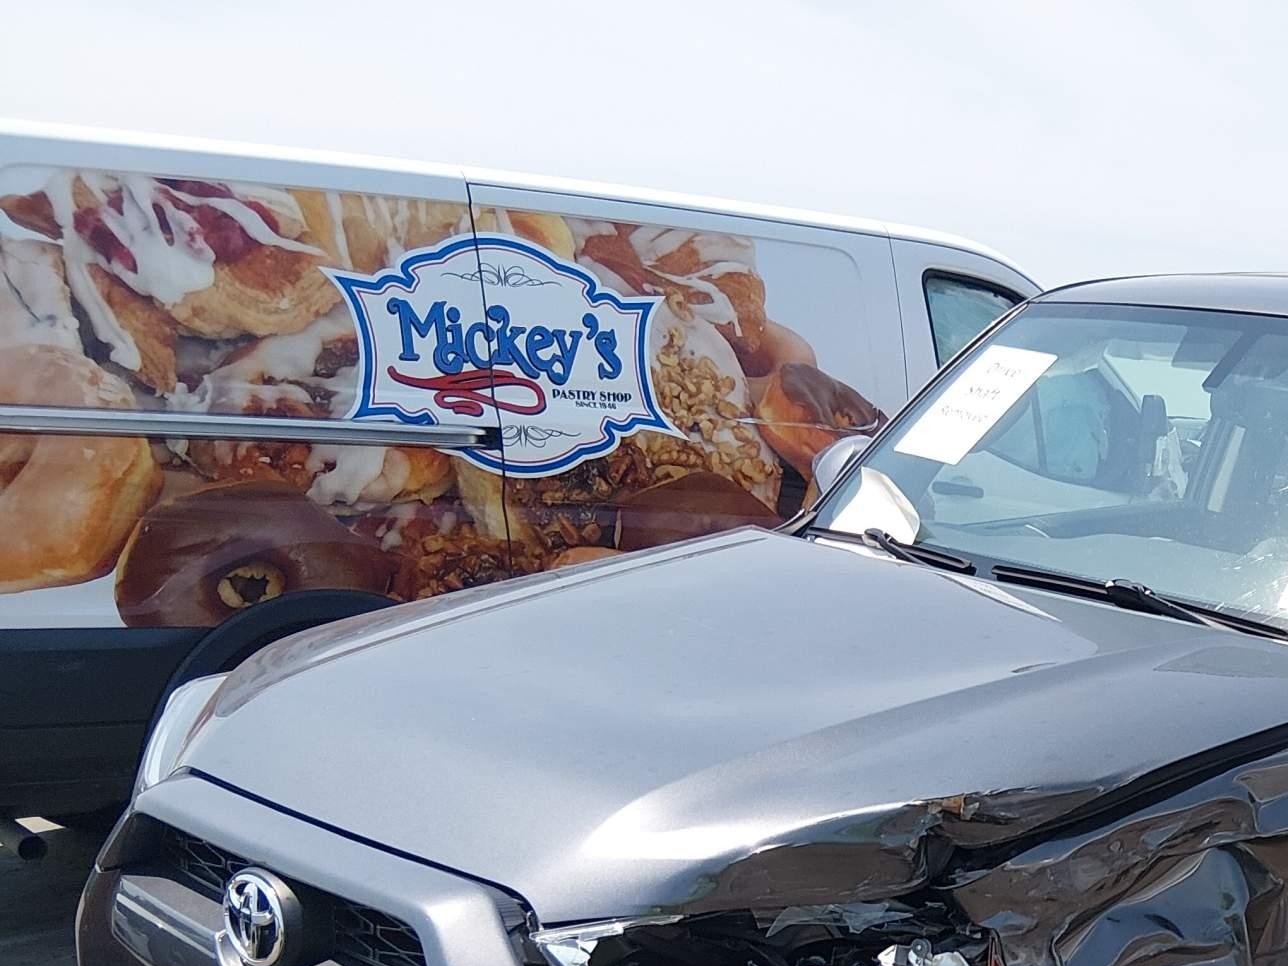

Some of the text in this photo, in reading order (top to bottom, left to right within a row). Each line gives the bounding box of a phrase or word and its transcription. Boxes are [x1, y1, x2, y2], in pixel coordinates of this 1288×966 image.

[387, 297, 622, 385] Mickey's
[552, 388, 632, 403] PASTRY SHOP
